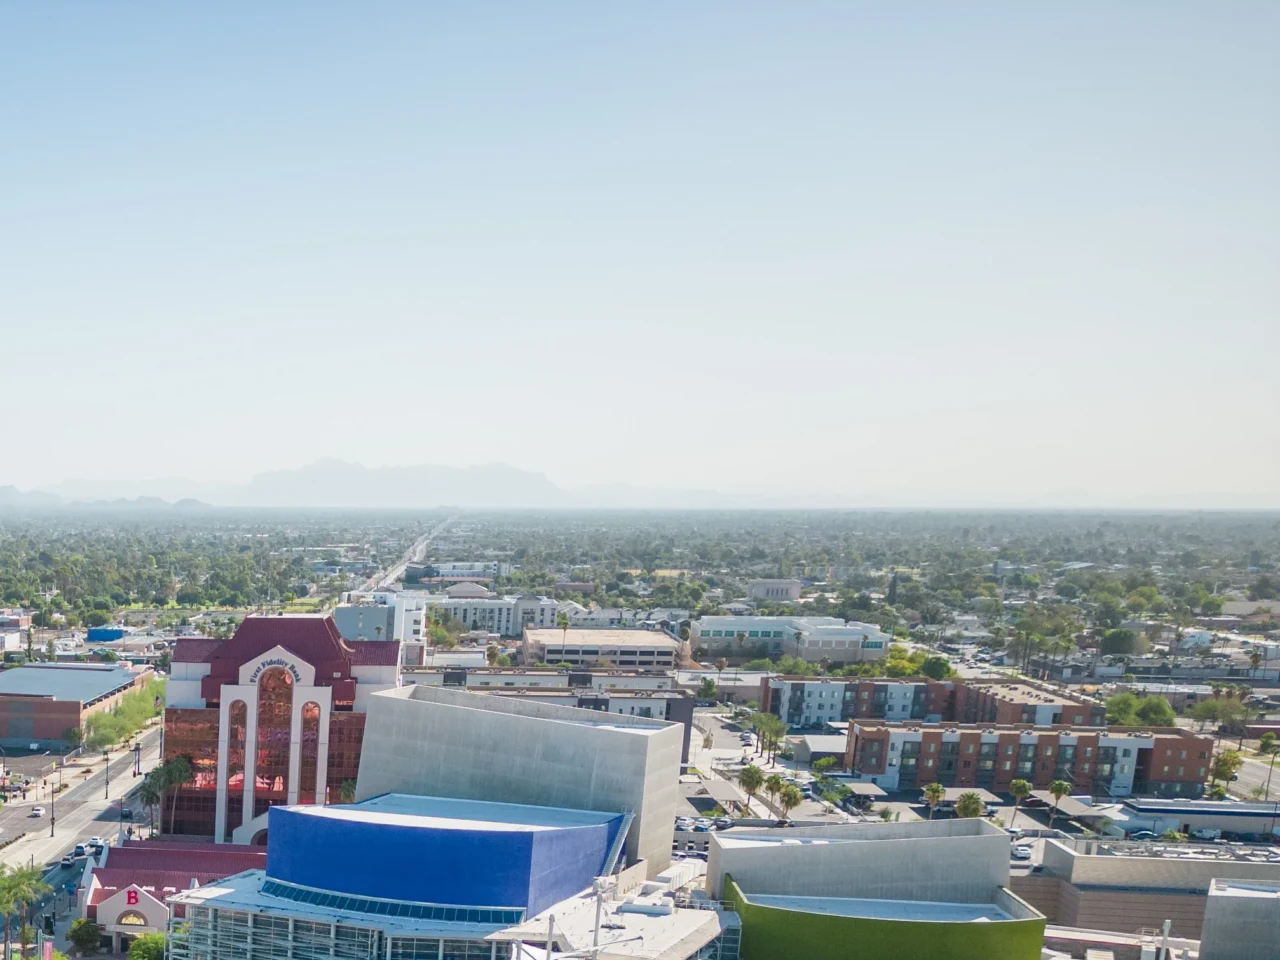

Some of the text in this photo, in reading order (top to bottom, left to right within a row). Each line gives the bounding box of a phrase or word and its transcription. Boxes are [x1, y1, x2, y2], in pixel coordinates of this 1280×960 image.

[249, 659, 302, 683] First Fidelity Bank
[126, 889, 139, 905] B
